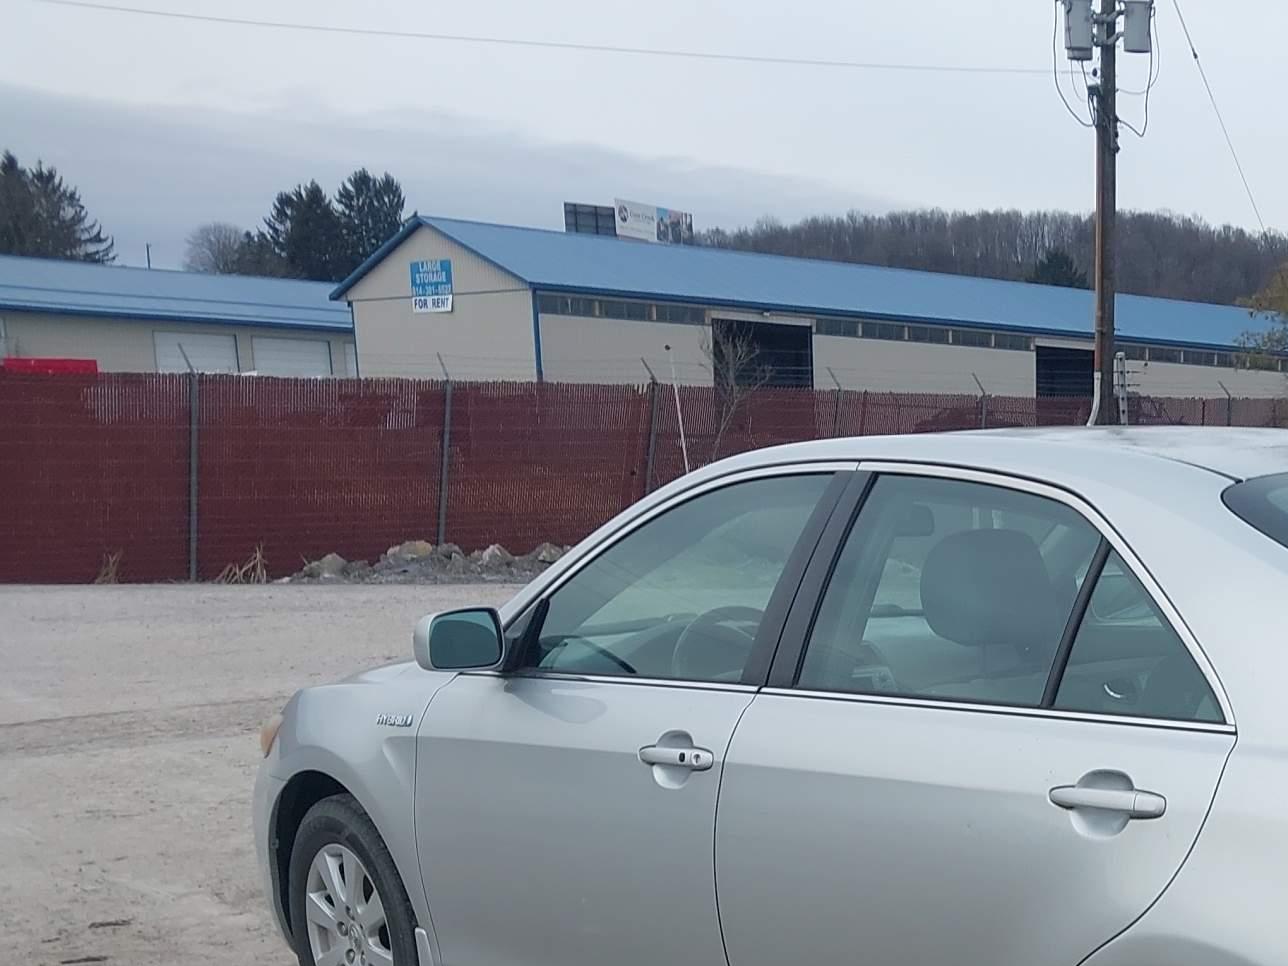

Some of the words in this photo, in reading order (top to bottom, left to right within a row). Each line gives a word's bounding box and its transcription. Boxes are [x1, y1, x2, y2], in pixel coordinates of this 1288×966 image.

[415, 271, 447, 284] STORAGE
[414, 298, 429, 310] FOR
[431, 297, 449, 309] RENT
